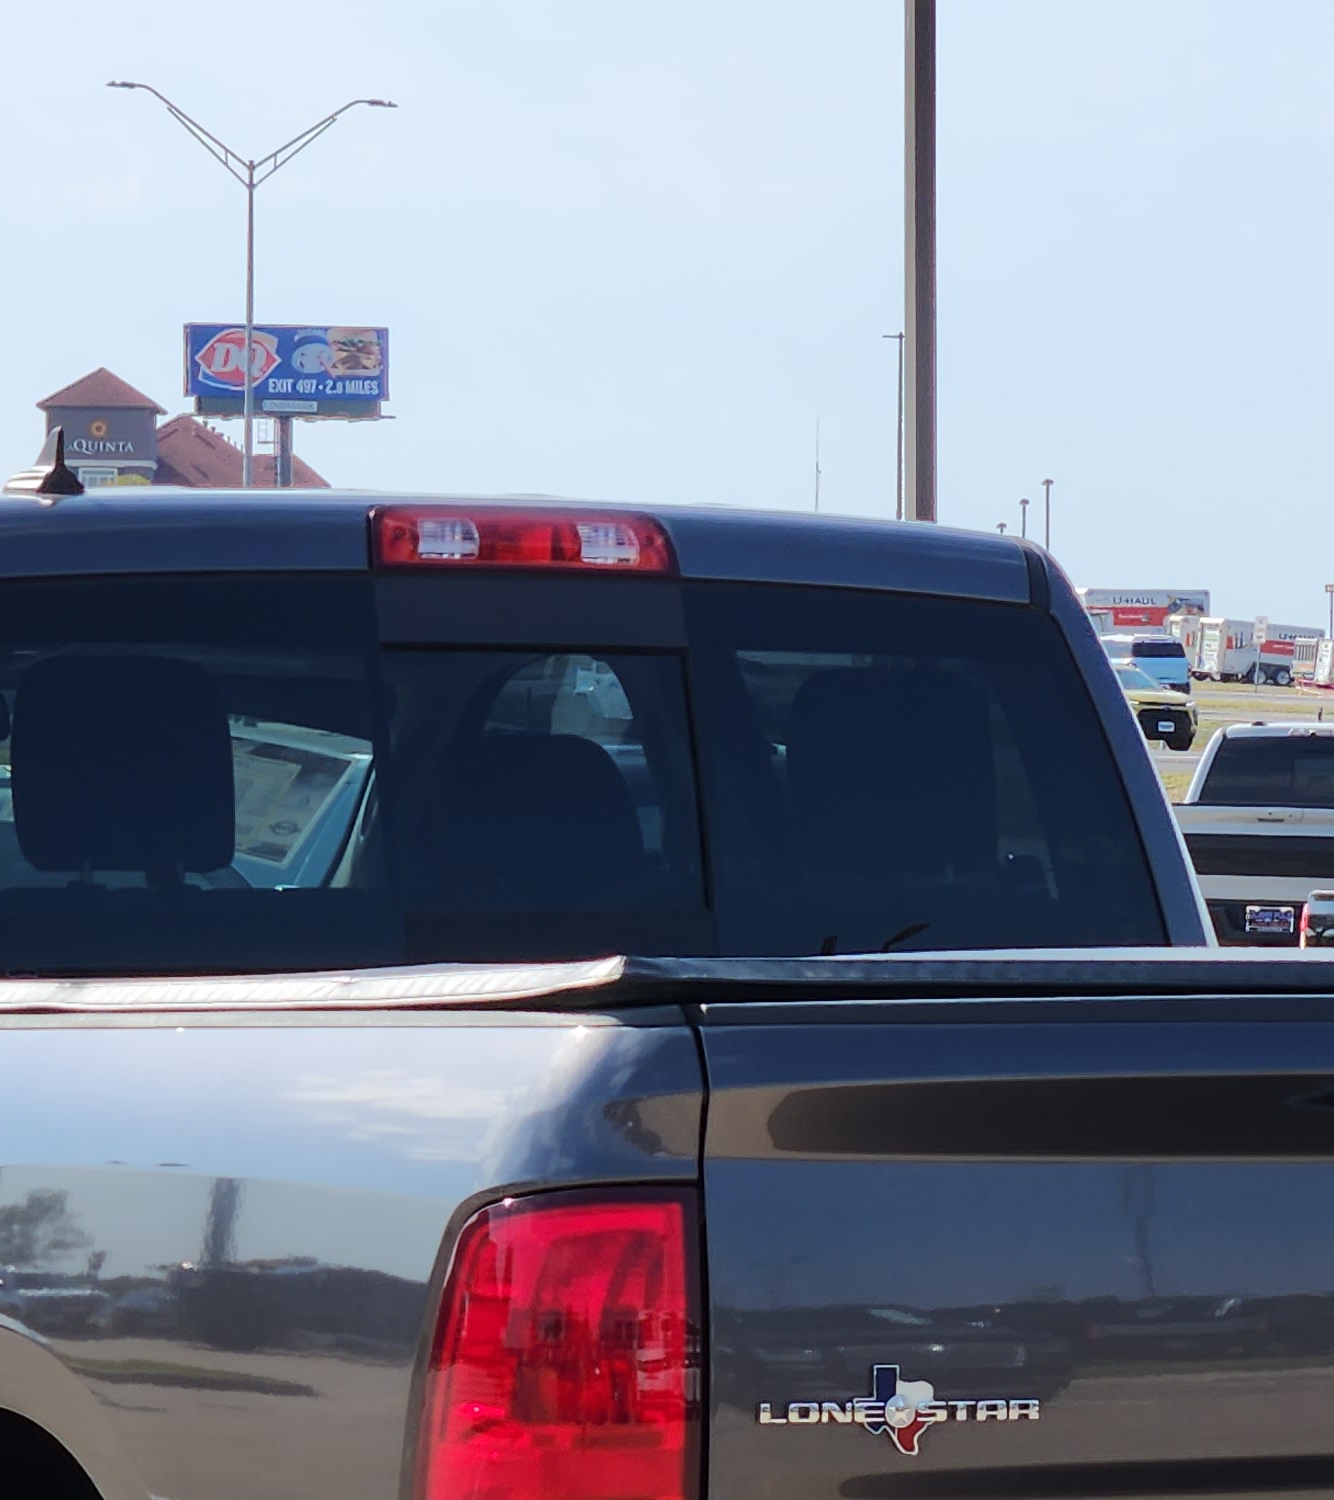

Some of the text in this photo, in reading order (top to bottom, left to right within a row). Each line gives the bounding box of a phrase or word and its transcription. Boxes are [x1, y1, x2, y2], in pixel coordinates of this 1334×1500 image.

[211, 341, 267, 378] DQ
[268, 378, 292, 394] EXIT
[295, 378, 317, 394] 497
[345, 379, 379, 395] MILES
[73, 439, 134, 454] QUINTA
[759, 1399, 1040, 1424] LONE STAR
